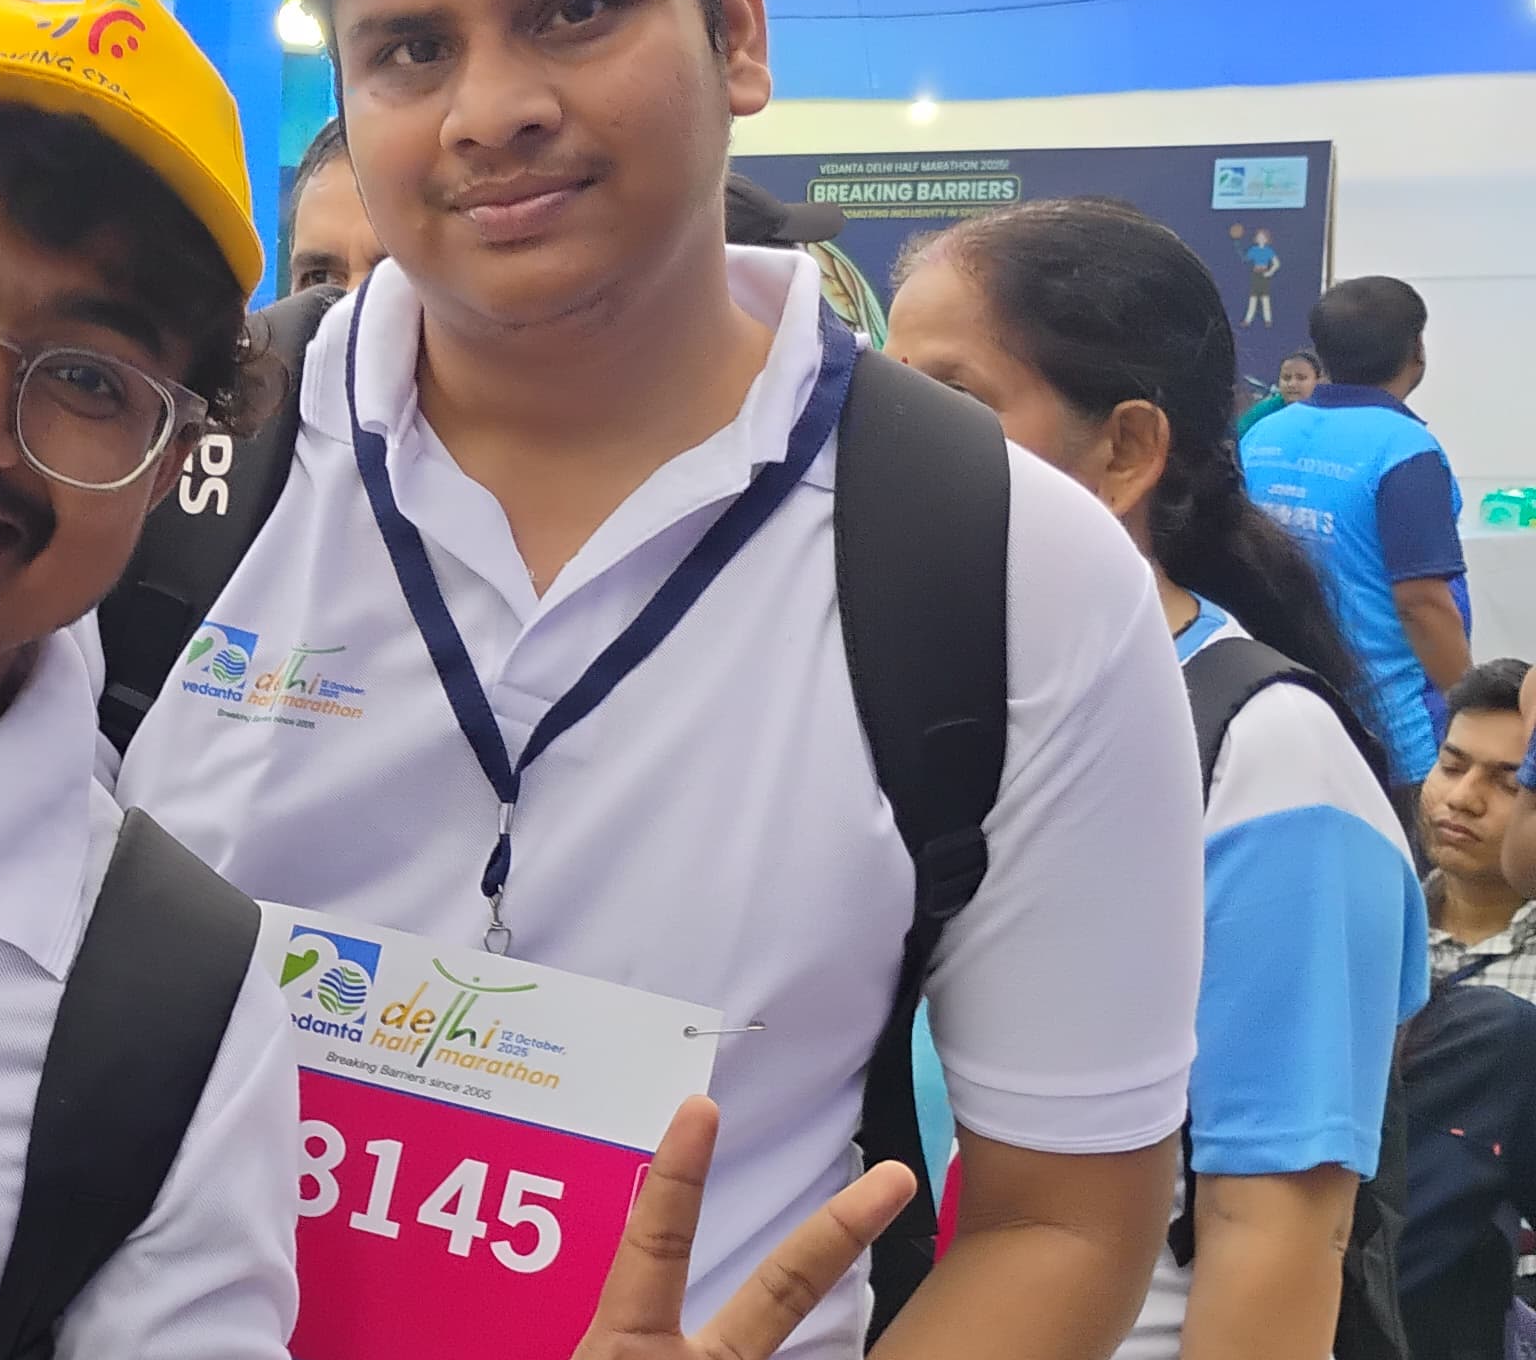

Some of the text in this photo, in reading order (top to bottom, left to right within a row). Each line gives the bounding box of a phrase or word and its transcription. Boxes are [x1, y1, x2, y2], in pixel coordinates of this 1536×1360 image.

[819, 162, 864, 175] VEDANTA
[865, 162, 892, 174] DELHI
[894, 161, 920, 173] HALF
[921, 160, 978, 172] MARATHON
[814, 180, 1015, 204] BREAKING BARRIERS
[181, 679, 244, 703] vedanta
[280, 694, 364, 720] marathon
[290, 1012, 363, 1044] danta
[379, 980, 502, 1068] delhi
[500, 1028, 512, 1041] 12
[326, 1050, 492, 1101] Breaking Barriers since 2005
[368, 1026, 561, 1090] half marathon 2025
[298, 1118, 565, 1275] 8145
